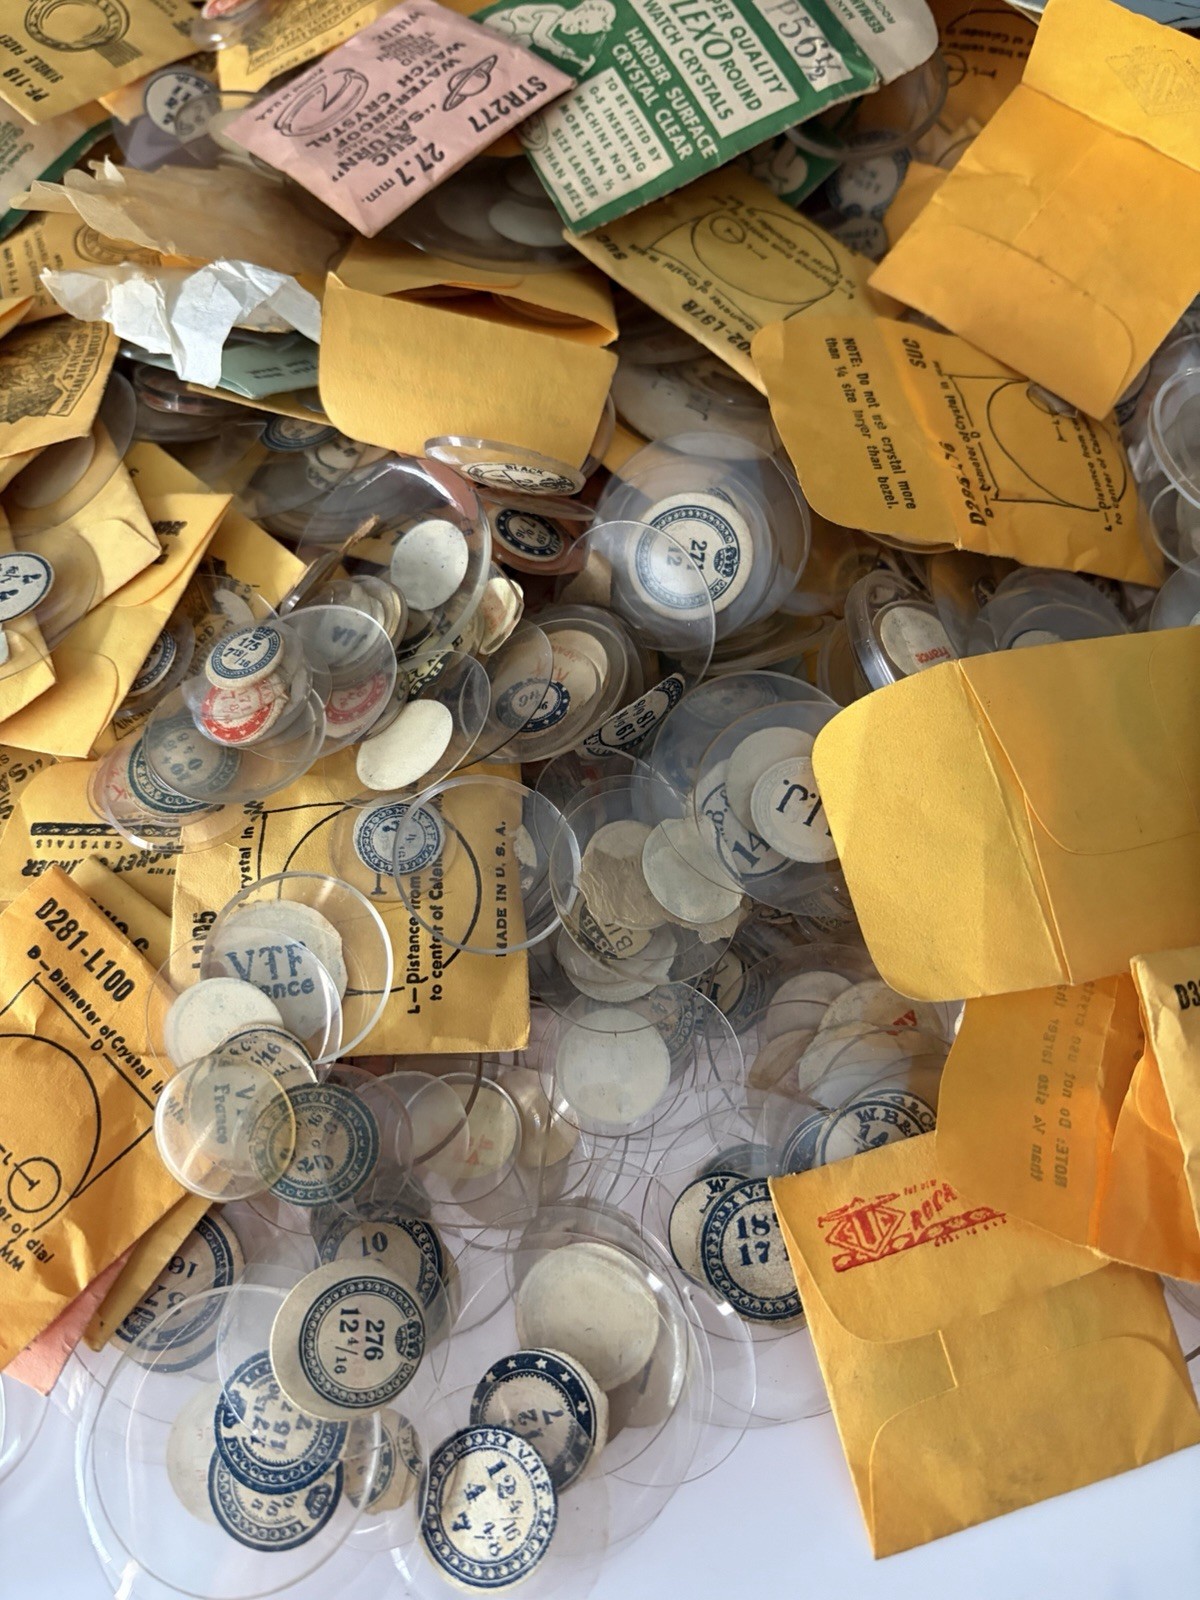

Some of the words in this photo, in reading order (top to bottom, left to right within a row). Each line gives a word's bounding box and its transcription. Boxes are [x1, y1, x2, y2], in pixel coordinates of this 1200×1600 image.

[23, 55, 63, 83] SINGLE
[395, 37, 465, 89] WATCH
[642, 0, 686, 48] WATCH
[676, 44, 734, 123] CRYSTALS
[670, 0, 734, 65] LEXO
[718, 55, 763, 114] ROUND
[727, 23, 787, 98] QUALITY
[305, 90, 392, 154] CRYSTAL
[330, 54, 463, 150] WATERPROOF
[467, 71, 548, 135] STR277
[604, 76, 618, 92] TO
[614, 93, 628, 108] BE
[624, 109, 651, 144] FITTED
[647, 146, 662, 162] BY
[610, 40, 660, 108] CRYSTAL
[652, 106, 694, 161] CLEAR
[624, 24, 672, 86] HARDER
[663, 85, 718, 160] SURFACE
[368, 129, 418, 169] SUC
[557, 103, 584, 139] MORE
[580, 141, 607, 176] THAN
[572, 94, 612, 150] MACHINE
[608, 152, 631, 182] NOT
[587, 85, 605, 105] G-S
[600, 106, 647, 173] INSERTING
[392, 139, 447, 187] 27.7
[540, 146, 566, 179] THAN
[561, 181, 589, 217] BEZEL
[551, 127, 572, 153] SIZE
[566, 154, 599, 199] LARGER
[590, 230, 631, 263] SUC
[902, 337, 928, 369] SUC
[825, 337, 841, 360] than
[840, 381, 858, 404] size
[850, 407, 872, 440] larger
[866, 443, 883, 471] than
[877, 474, 899, 510] bezel.
[842, 336, 863, 368] NOTE:
[856, 371, 870, 386] Do
[863, 388, 879, 409] not
[879, 435, 905, 475] crystal
[897, 479, 917, 511] more
[504, 463, 543, 475] BLACK
[238, 637, 263, 653] 175
[236, 846, 254, 892] rystal
[495, 883, 507, 902] IN
[33, 894, 138, 1004] D281-L100
[47, 967, 104, 1027] Diameter
[98, 1021, 117, 1040] of
[108, 1034, 154, 1081] Crystal
[1175, 981, 1200, 1010] D3
[89, 1037, 105, 1053] D
[26, 1240, 55, 1264] dial
[734, 1211, 780, 1239] 18
[365, 1318, 385, 1362] 276
